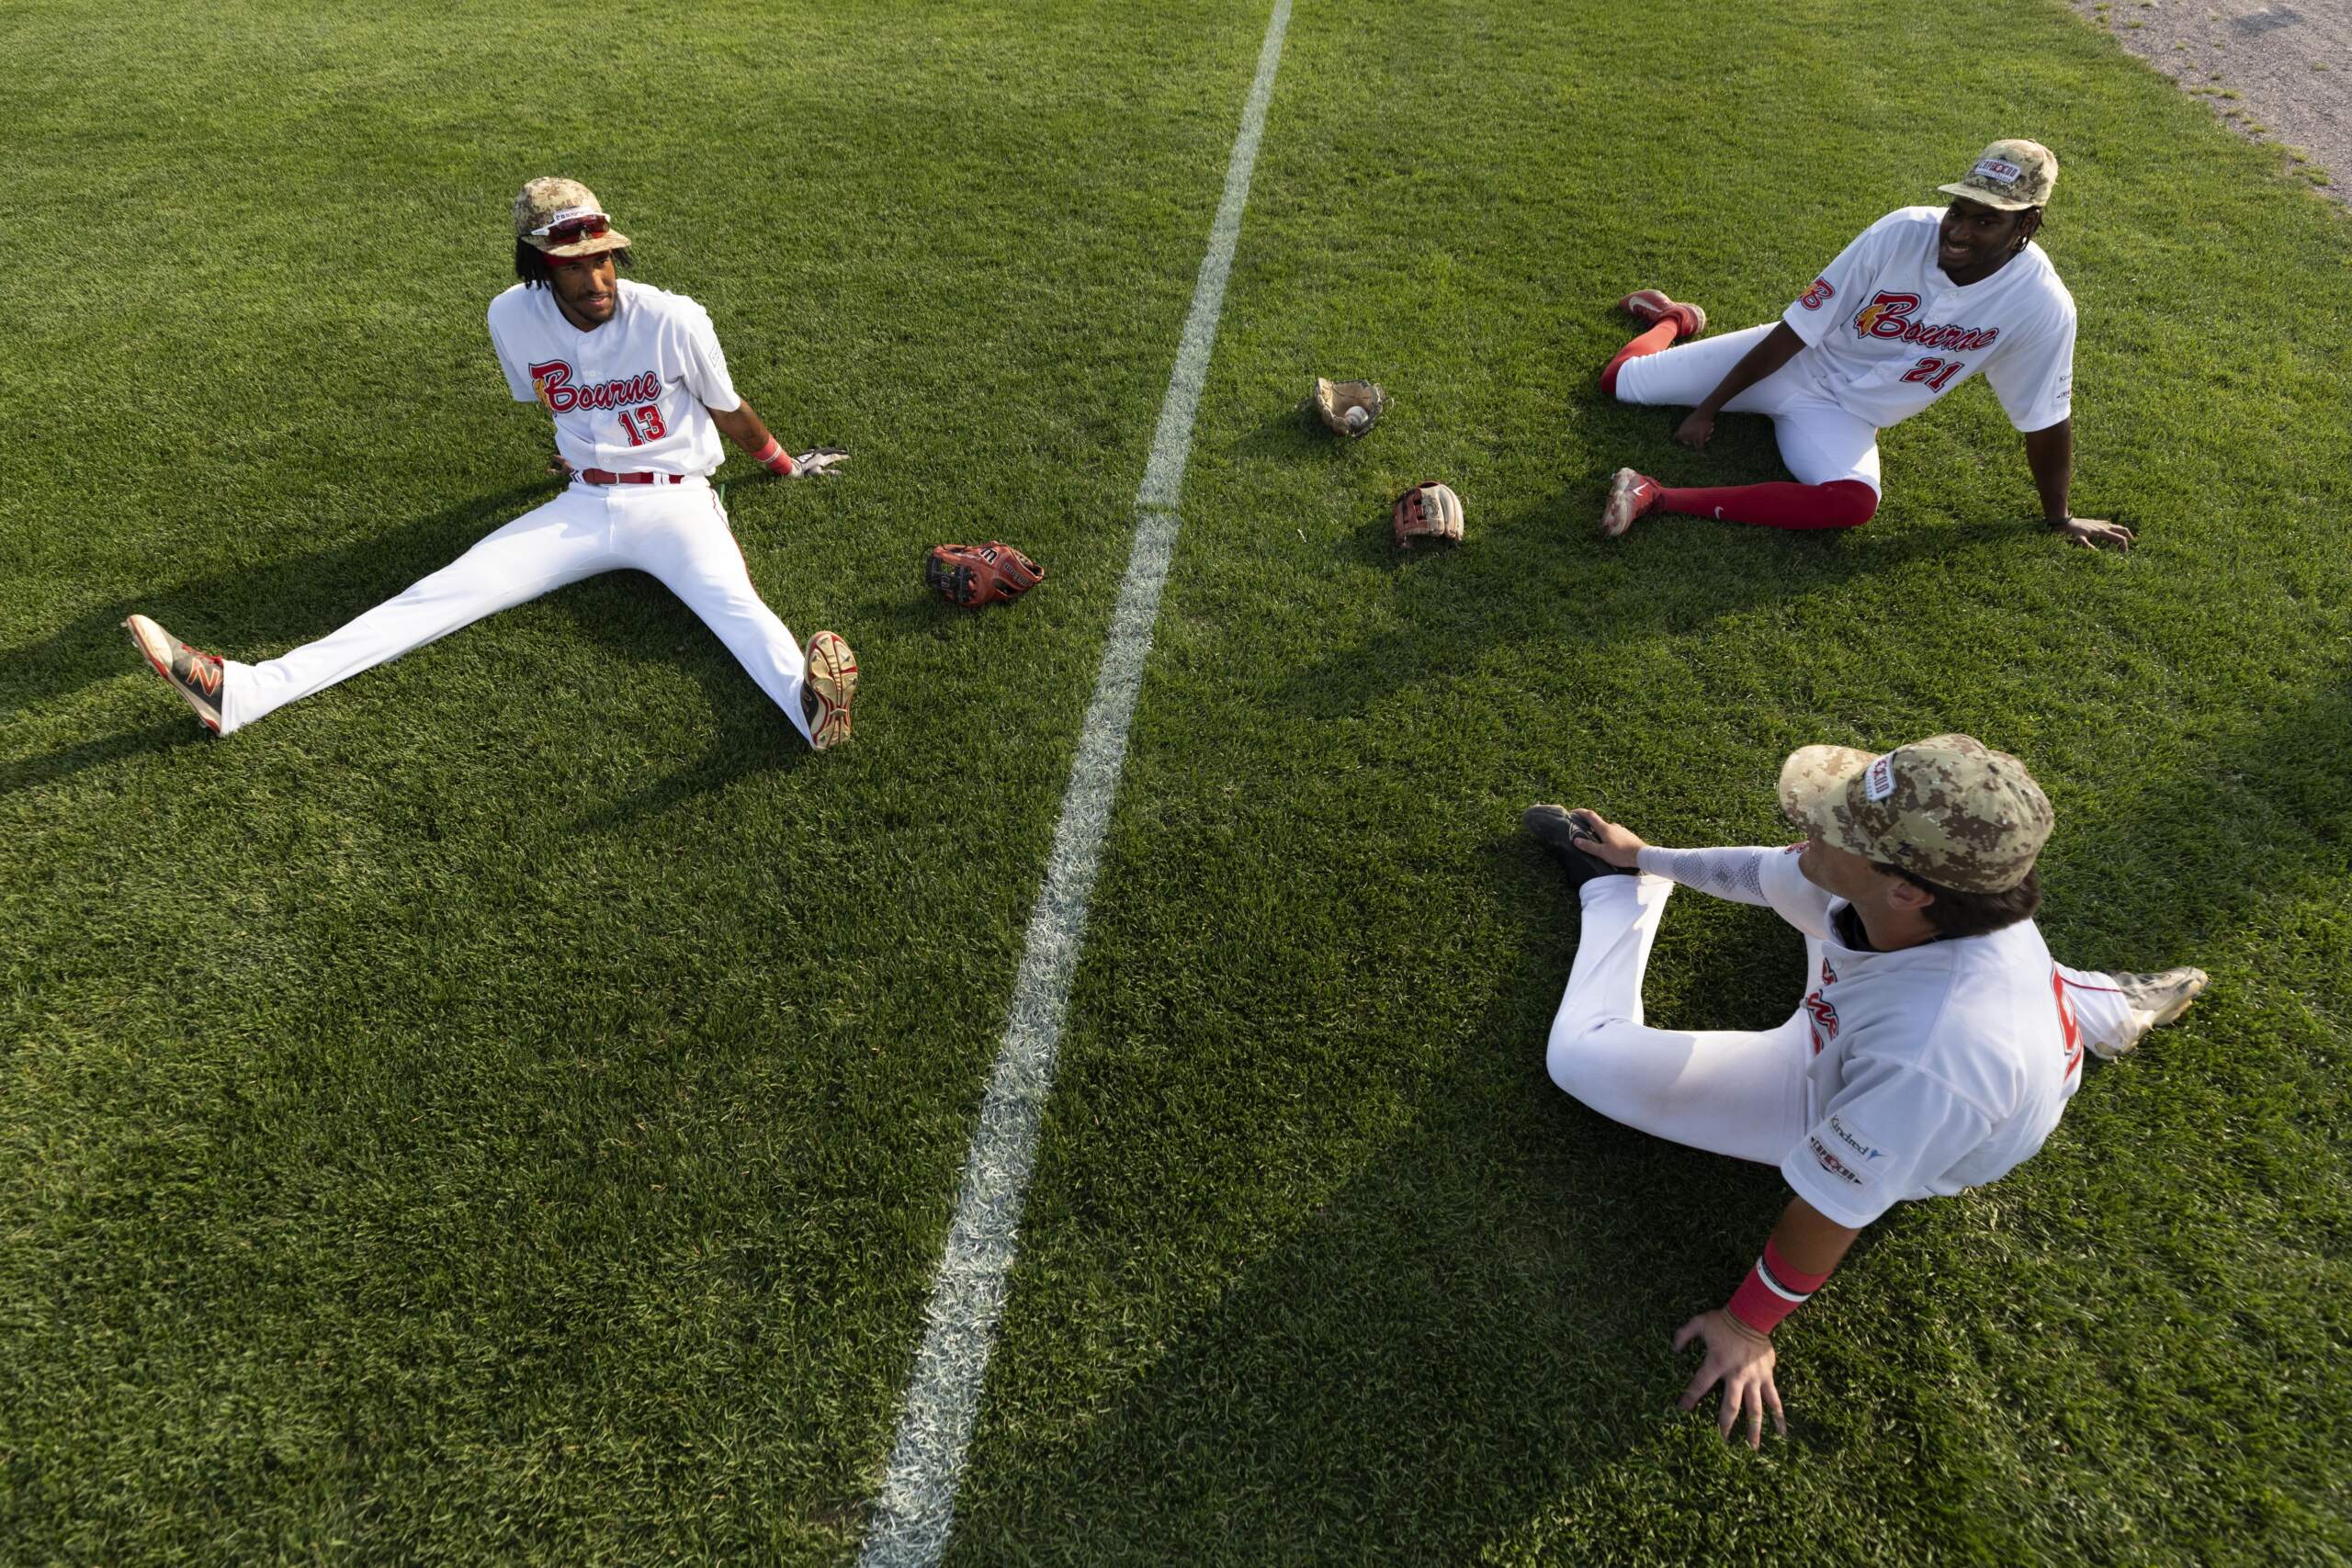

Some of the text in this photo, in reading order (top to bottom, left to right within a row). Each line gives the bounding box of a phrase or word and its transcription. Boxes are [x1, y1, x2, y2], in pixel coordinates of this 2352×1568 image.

[1798, 276, 1836, 310] B
[1865, 289, 2000, 352] Bourne
[528, 358, 662, 413] Bourne
[1899, 356, 1964, 393] 21
[617, 404, 667, 447] 13
[186, 658, 220, 697] N
[1830, 1114, 1870, 1156] Kindred
